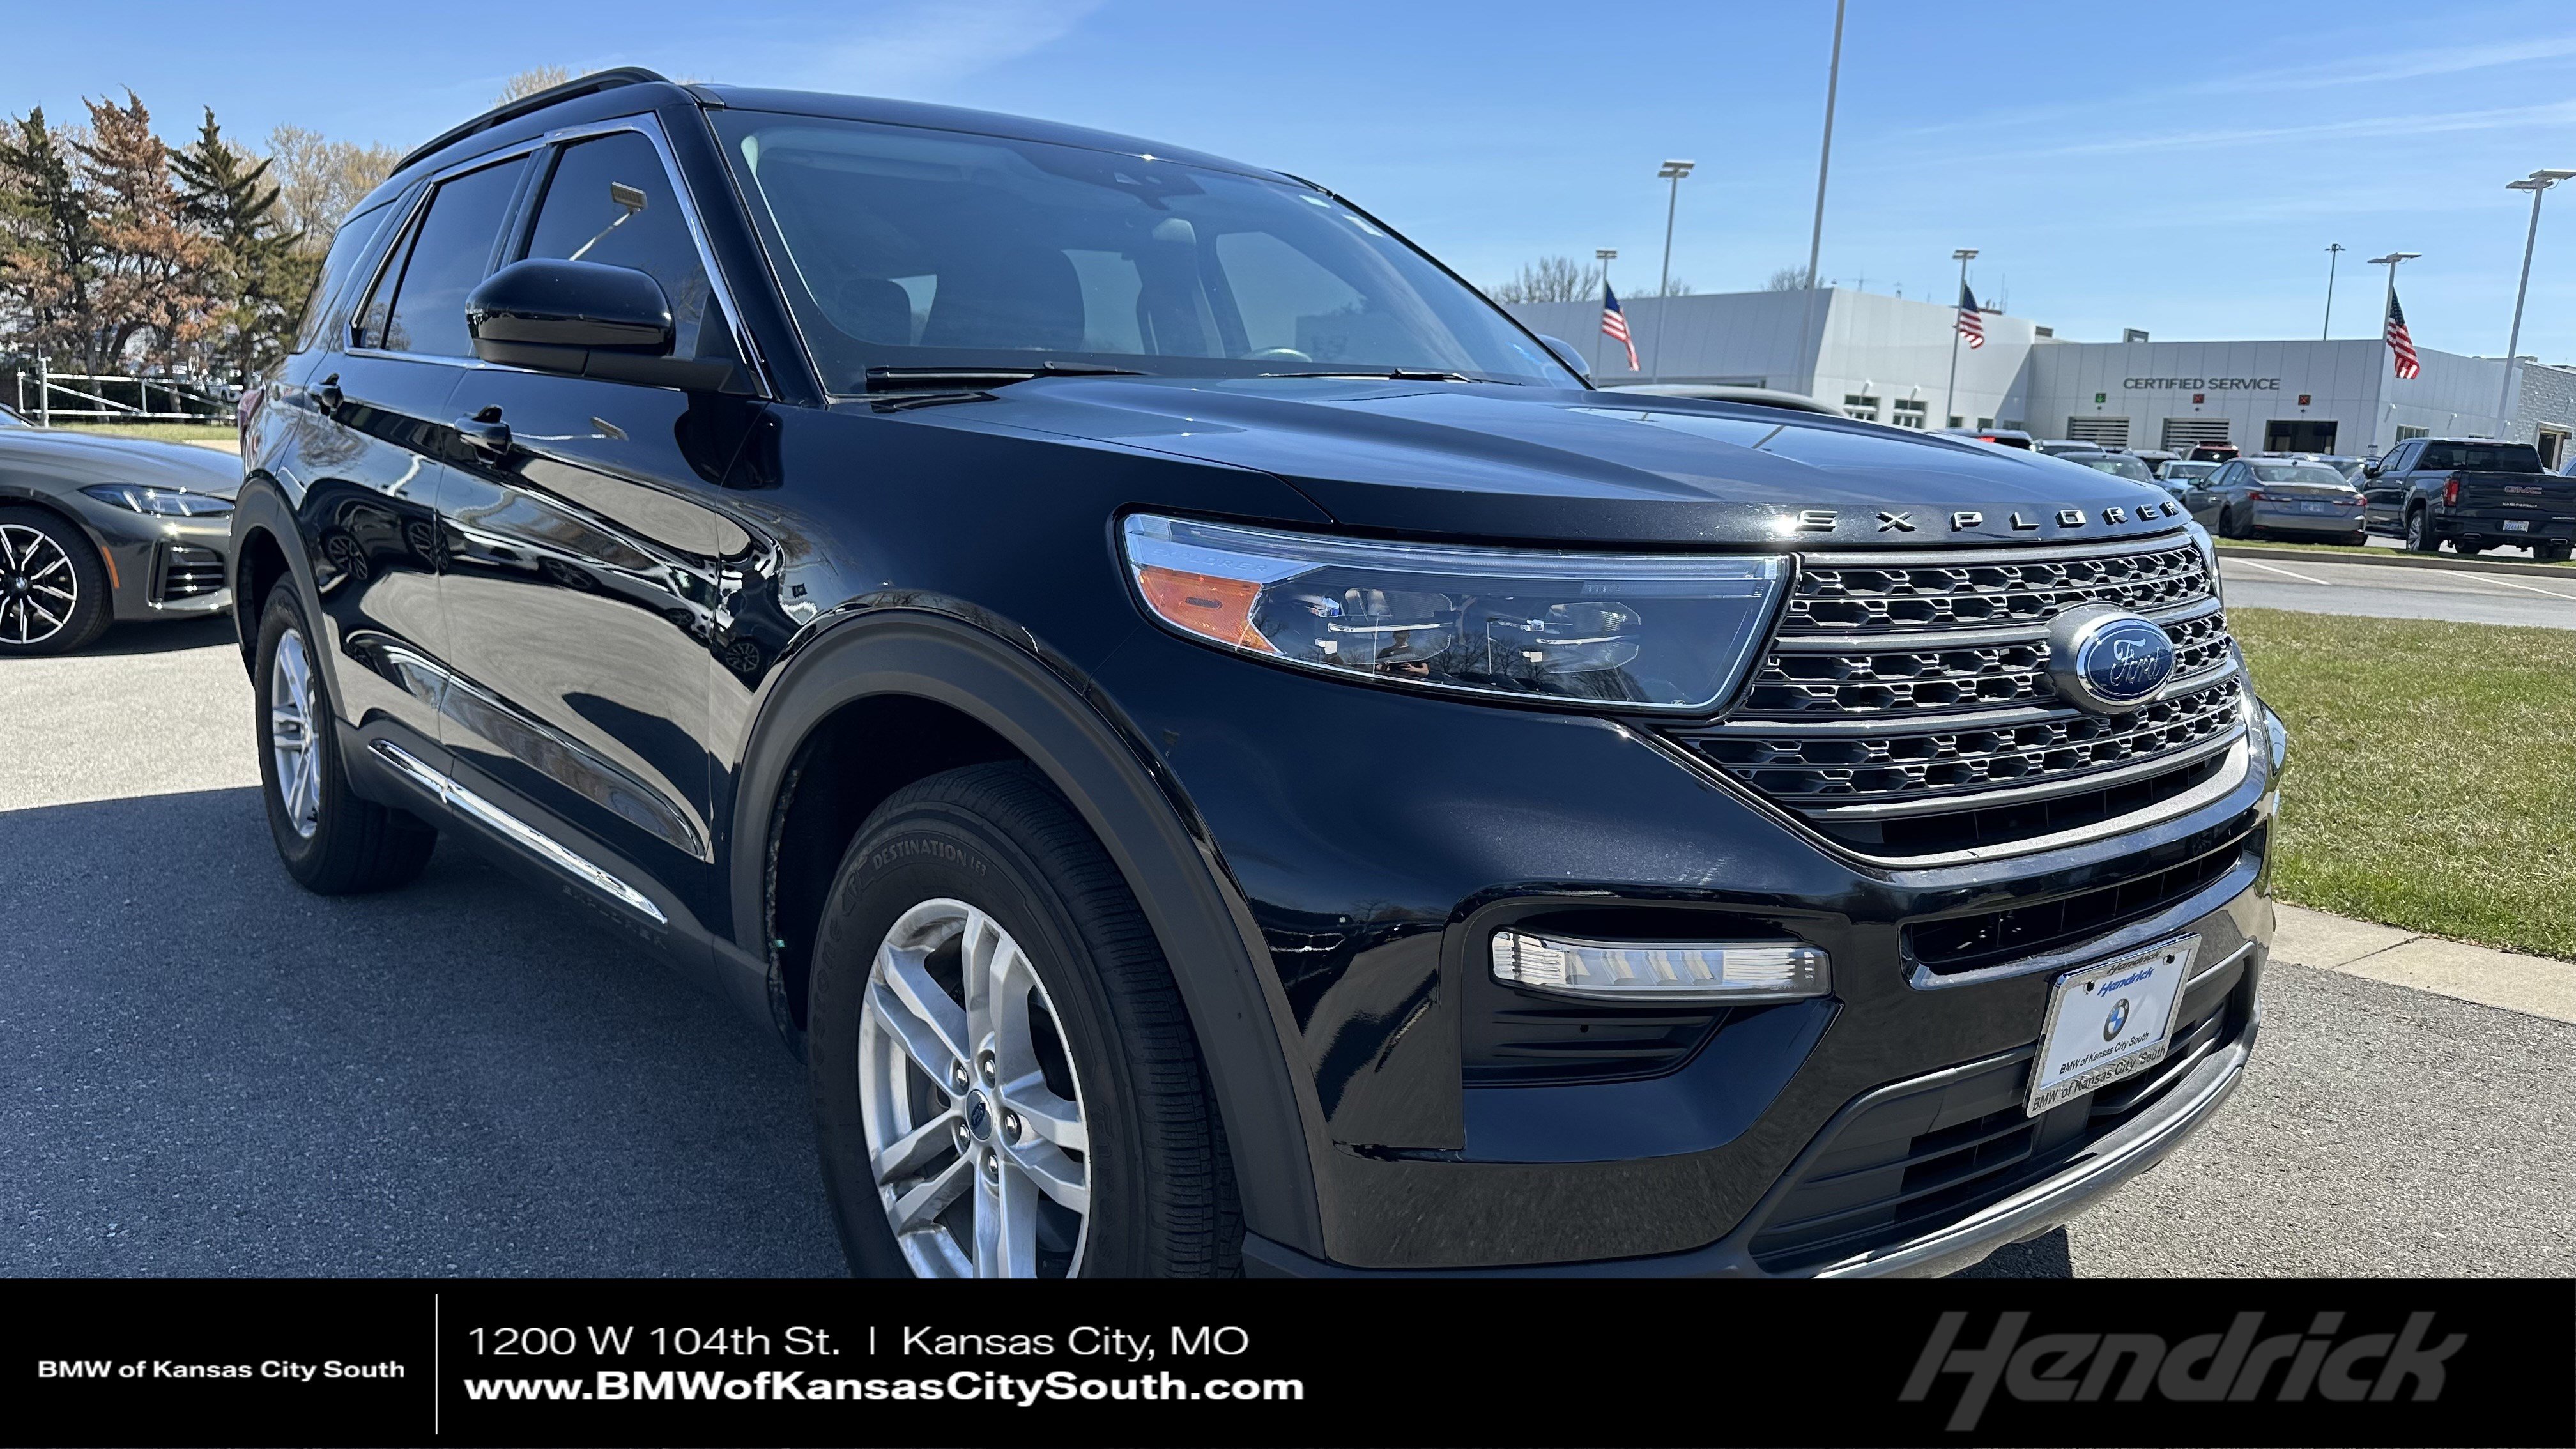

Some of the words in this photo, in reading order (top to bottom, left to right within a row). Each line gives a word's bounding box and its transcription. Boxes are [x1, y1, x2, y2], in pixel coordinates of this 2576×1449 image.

[2123, 378, 2204, 390] CERTIFIED
[2207, 378, 2281, 390] SERVICE
[2504, 486, 2543, 494] GMC
[1795, 501, 2180, 532] EXPLORER
[2110, 638, 2161, 687] Ford
[872, 839, 967, 871] DESTINATION
[2097, 966, 2155, 997] Hendrick
[2059, 1057, 2082, 1075] BMW
[2080, 1055, 2089, 1066] of
[2088, 1046, 2113, 1064] Kansas
[2114, 1040, 2129, 1052] City
[2129, 1031, 2149, 1046] South
[2032, 1089, 2059, 1111] BMW
[2060, 1080, 2074, 1098] of
[2074, 1068, 2112, 1093] Kansas
[2115, 1059, 2136, 1075] City
[2140, 1046, 2166, 1065] South
